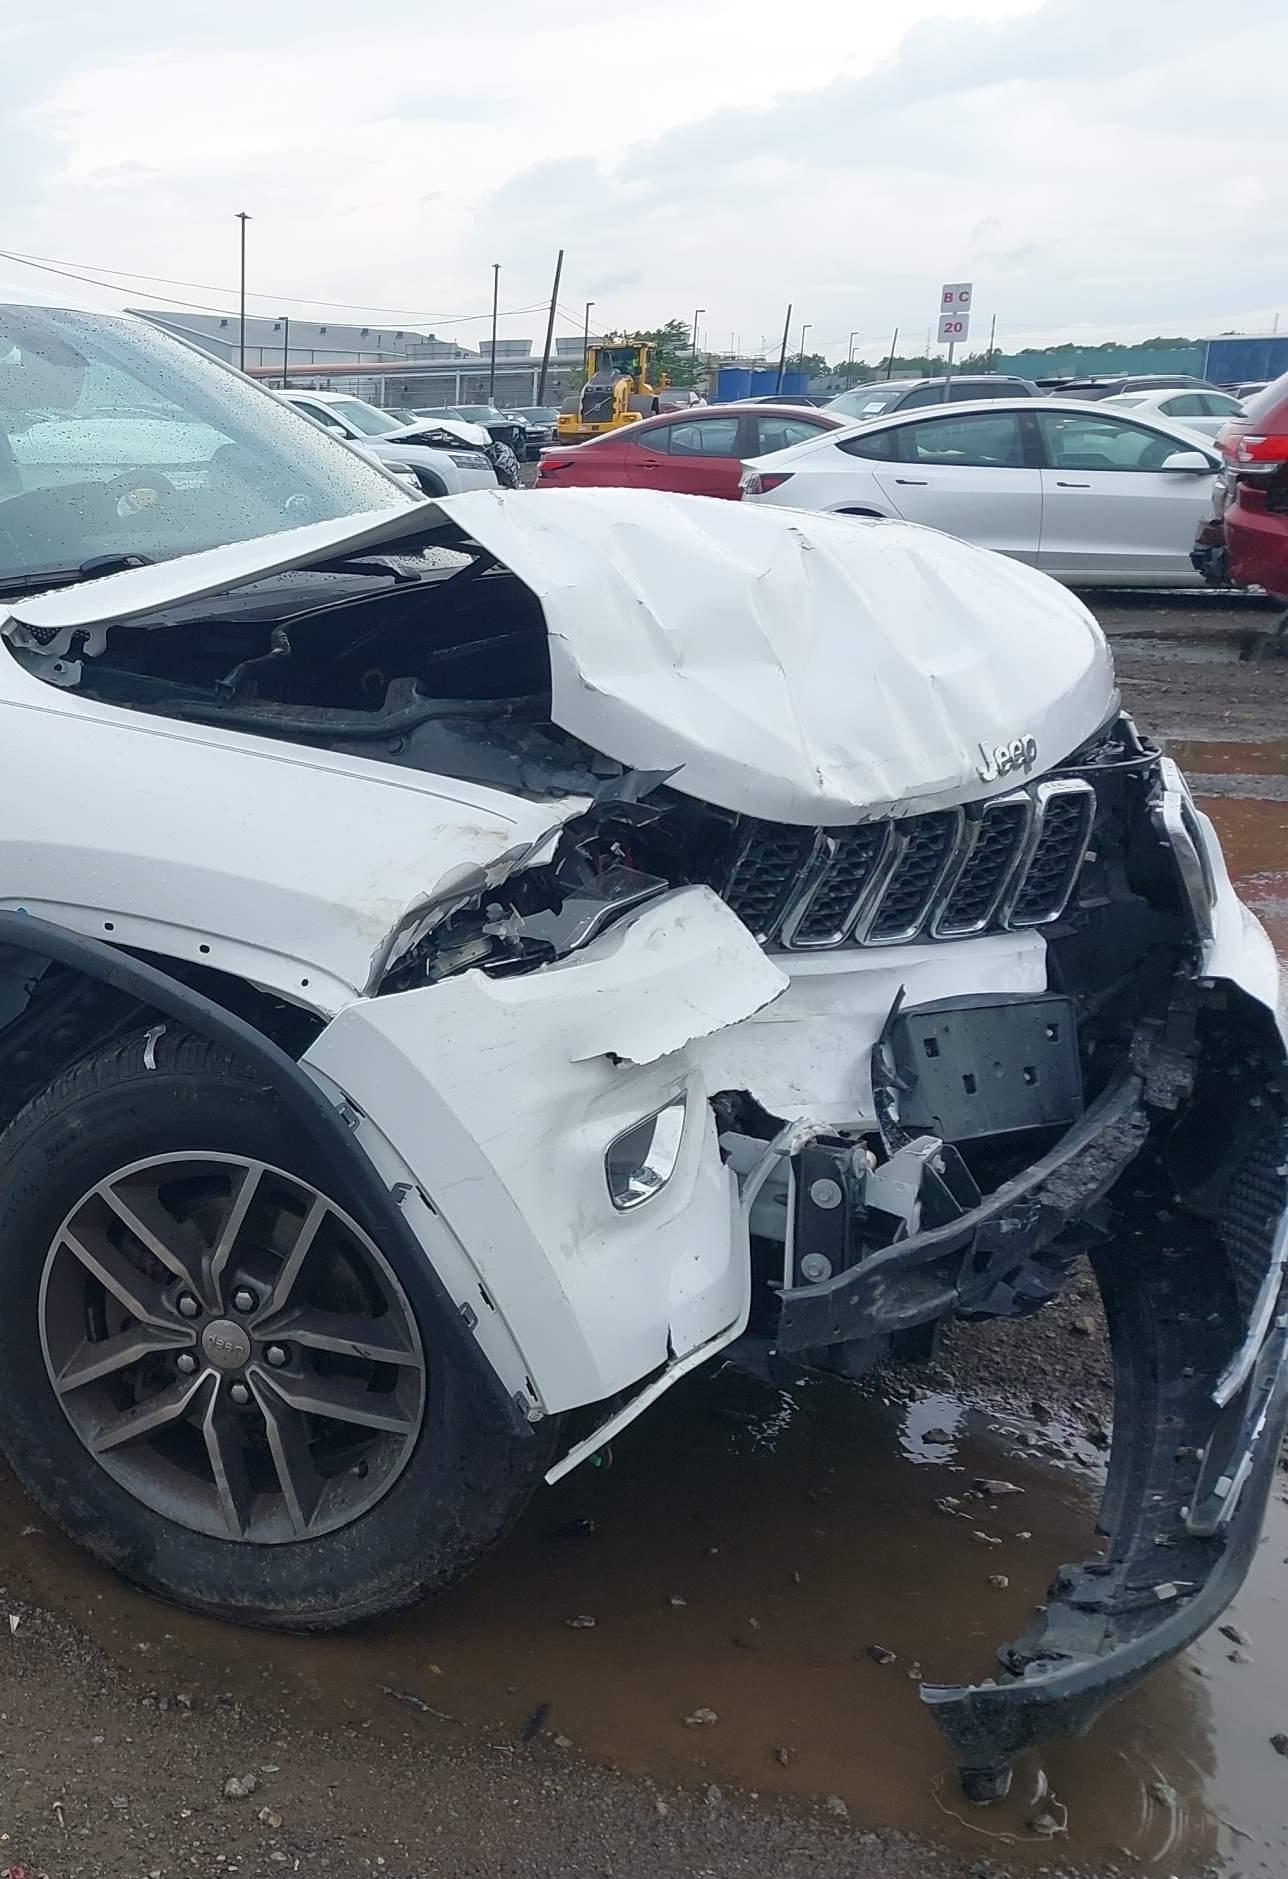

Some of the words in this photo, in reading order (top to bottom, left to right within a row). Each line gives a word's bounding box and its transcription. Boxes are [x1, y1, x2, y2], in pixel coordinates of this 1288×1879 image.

[943, 292, 953, 303] B
[958, 291, 969, 302] C
[943, 322, 962, 333] 20
[975, 734, 1037, 783] Jeep
